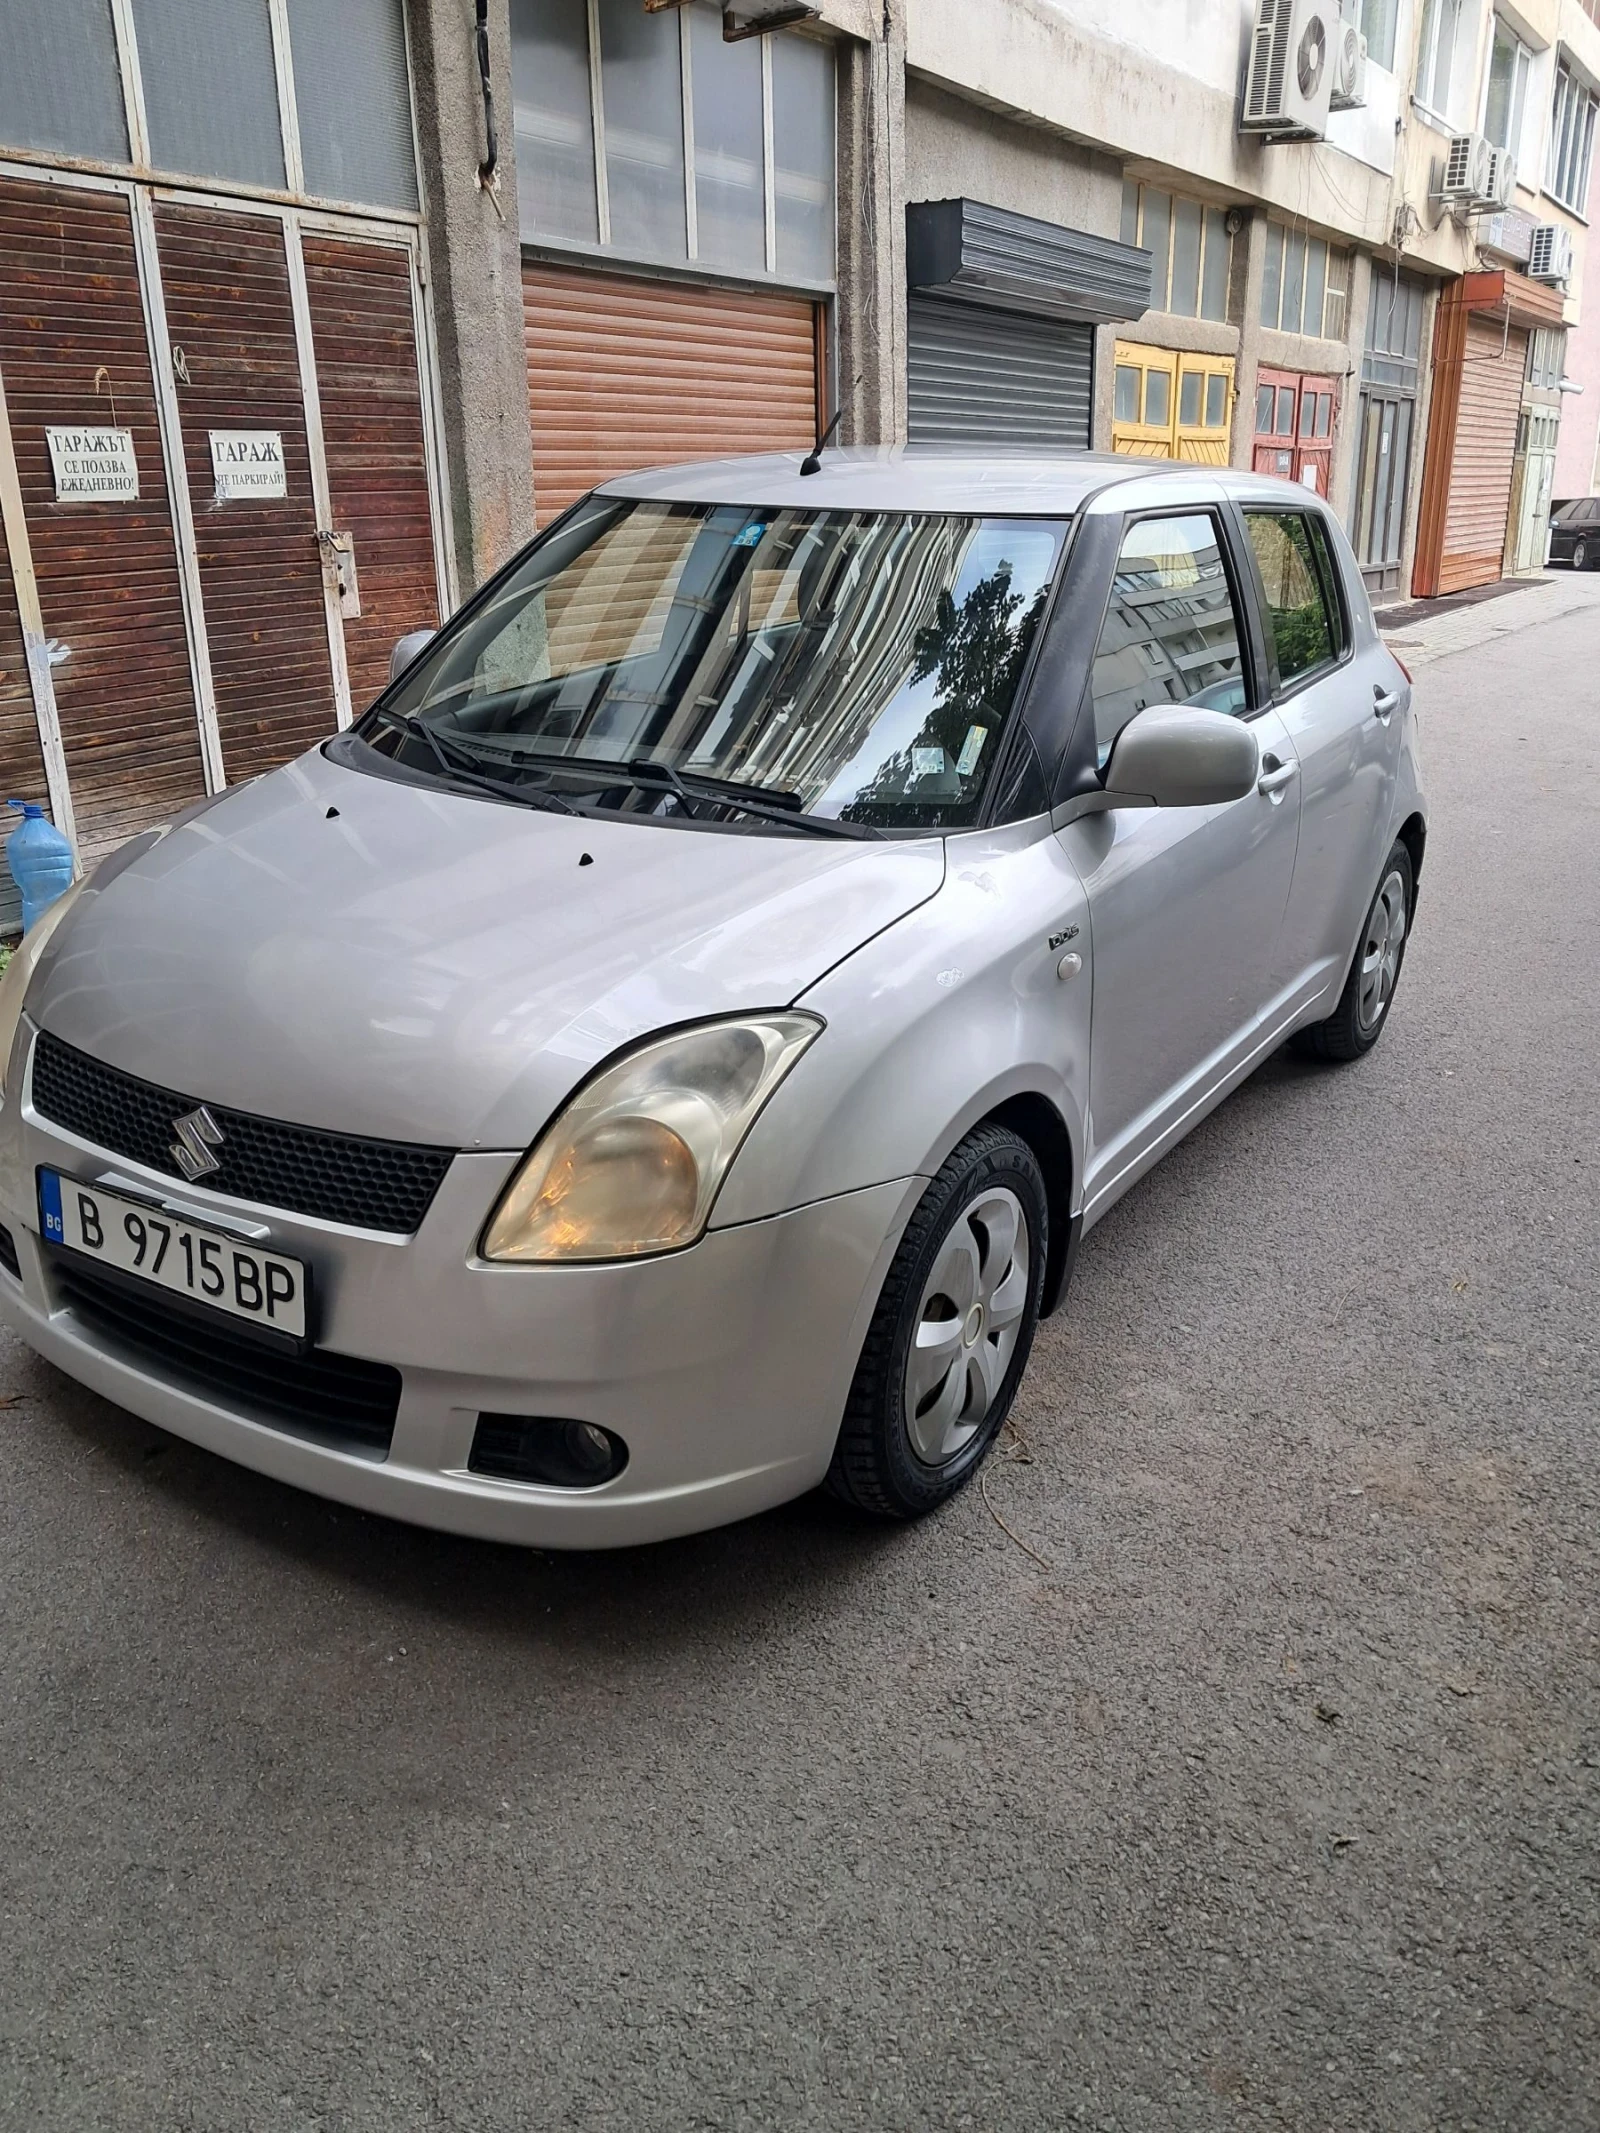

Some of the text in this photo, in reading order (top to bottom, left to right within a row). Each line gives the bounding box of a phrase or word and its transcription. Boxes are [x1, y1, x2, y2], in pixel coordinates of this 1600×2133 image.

[53, 435, 126, 453] ГАРАЖЪТ
[214, 441, 280, 462] ГАРАЖ
[64, 460, 127, 474] СЕ ПОЛЗВА
[60, 477, 135, 493] ЕЖЕДНЕВНО!
[232, 470, 285, 486] ПАРКИРАЙ!
[46, 1212, 62, 1232] BG
[78, 1192, 104, 1250] B
